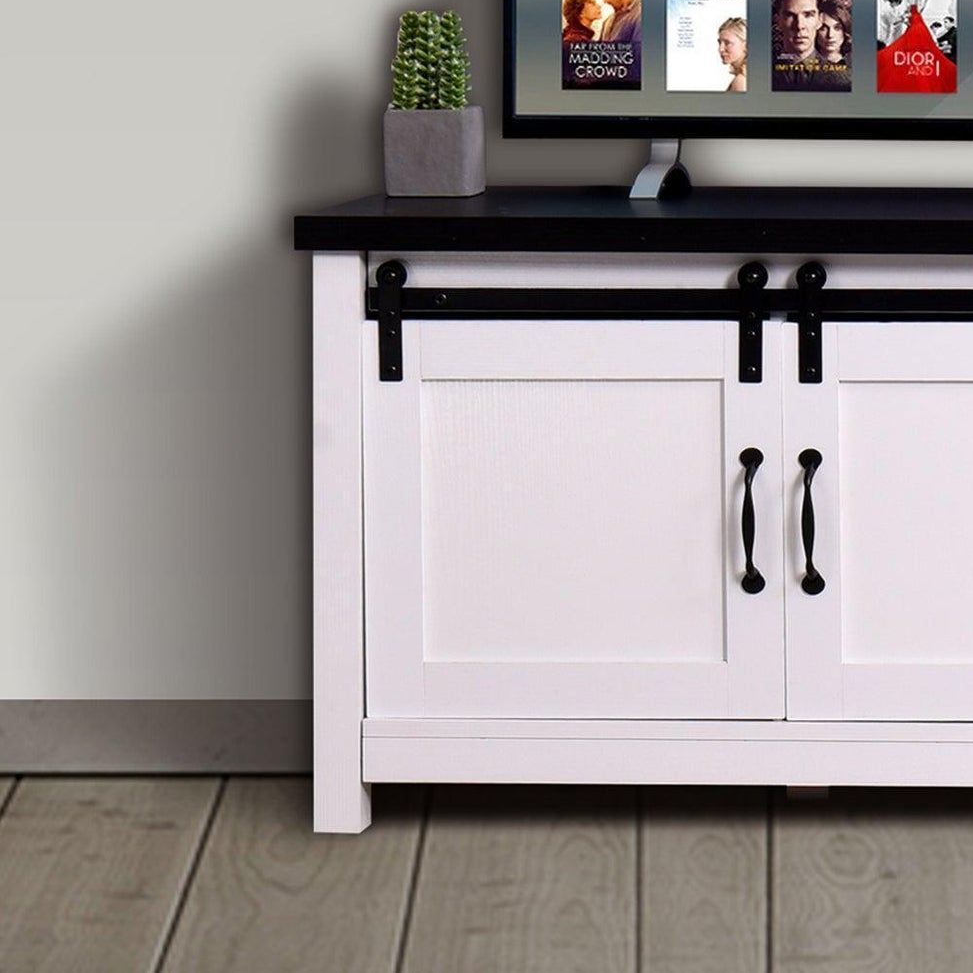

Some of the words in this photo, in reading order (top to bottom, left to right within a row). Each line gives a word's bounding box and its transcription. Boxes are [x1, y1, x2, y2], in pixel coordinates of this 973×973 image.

[589, 43, 616, 51] FROM
[568, 52, 634, 64] MADDING
[893, 50, 935, 66] DIOR
[575, 65, 628, 78] CROWD
[907, 66, 934, 76] AND
